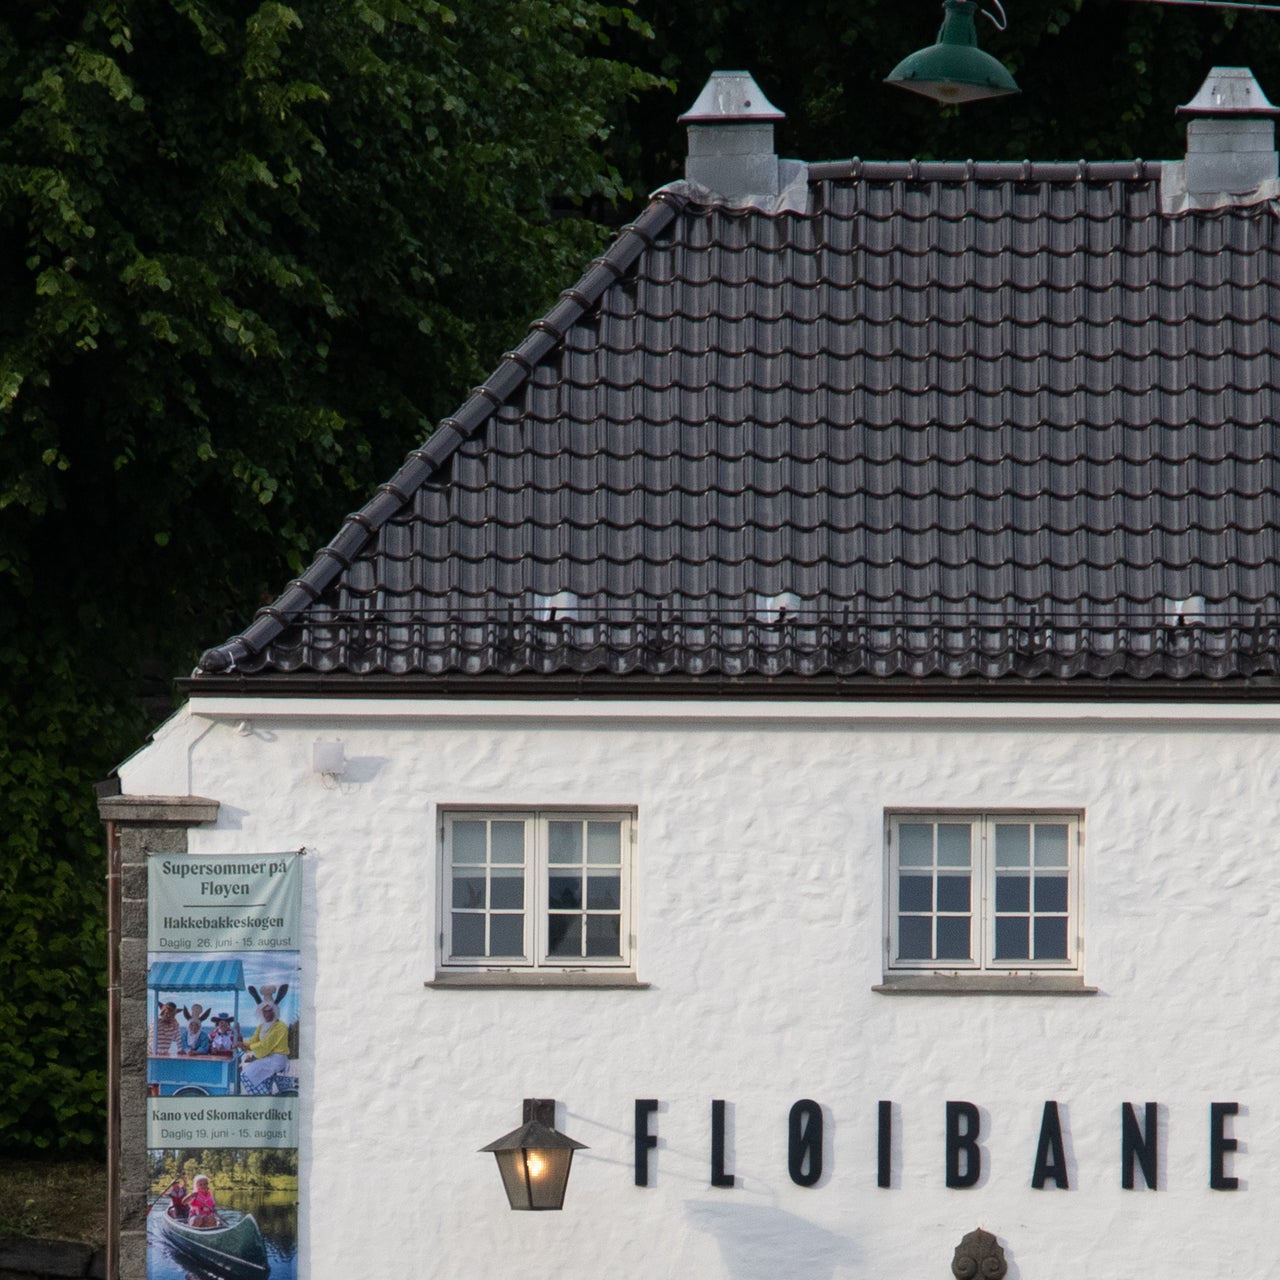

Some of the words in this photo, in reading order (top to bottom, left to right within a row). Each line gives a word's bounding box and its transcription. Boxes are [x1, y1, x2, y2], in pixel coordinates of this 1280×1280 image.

[162, 860, 267, 878] Supersommer
[270, 859, 287, 878] på
[200, 881, 250, 897] Fløyen
[163, 916, 284, 930] Hakkebakkeskogen
[159, 937, 191, 949] Daglig
[197, 938, 212, 948] 26.
[215, 937, 233, 949] juni
[242, 937, 255, 947] 15.
[258, 937, 291, 948] august
[152, 1110, 181, 1121] Kano
[184, 1109, 205, 1121] ved
[206, 1108, 292, 1121] Skomakerdiket
[161, 1128, 193, 1140] Daglig
[195, 1128, 208, 1138] 19.
[211, 1128, 229, 1140] juni
[239, 1128, 251, 1138] 15.
[254, 1129, 287, 1140] august
